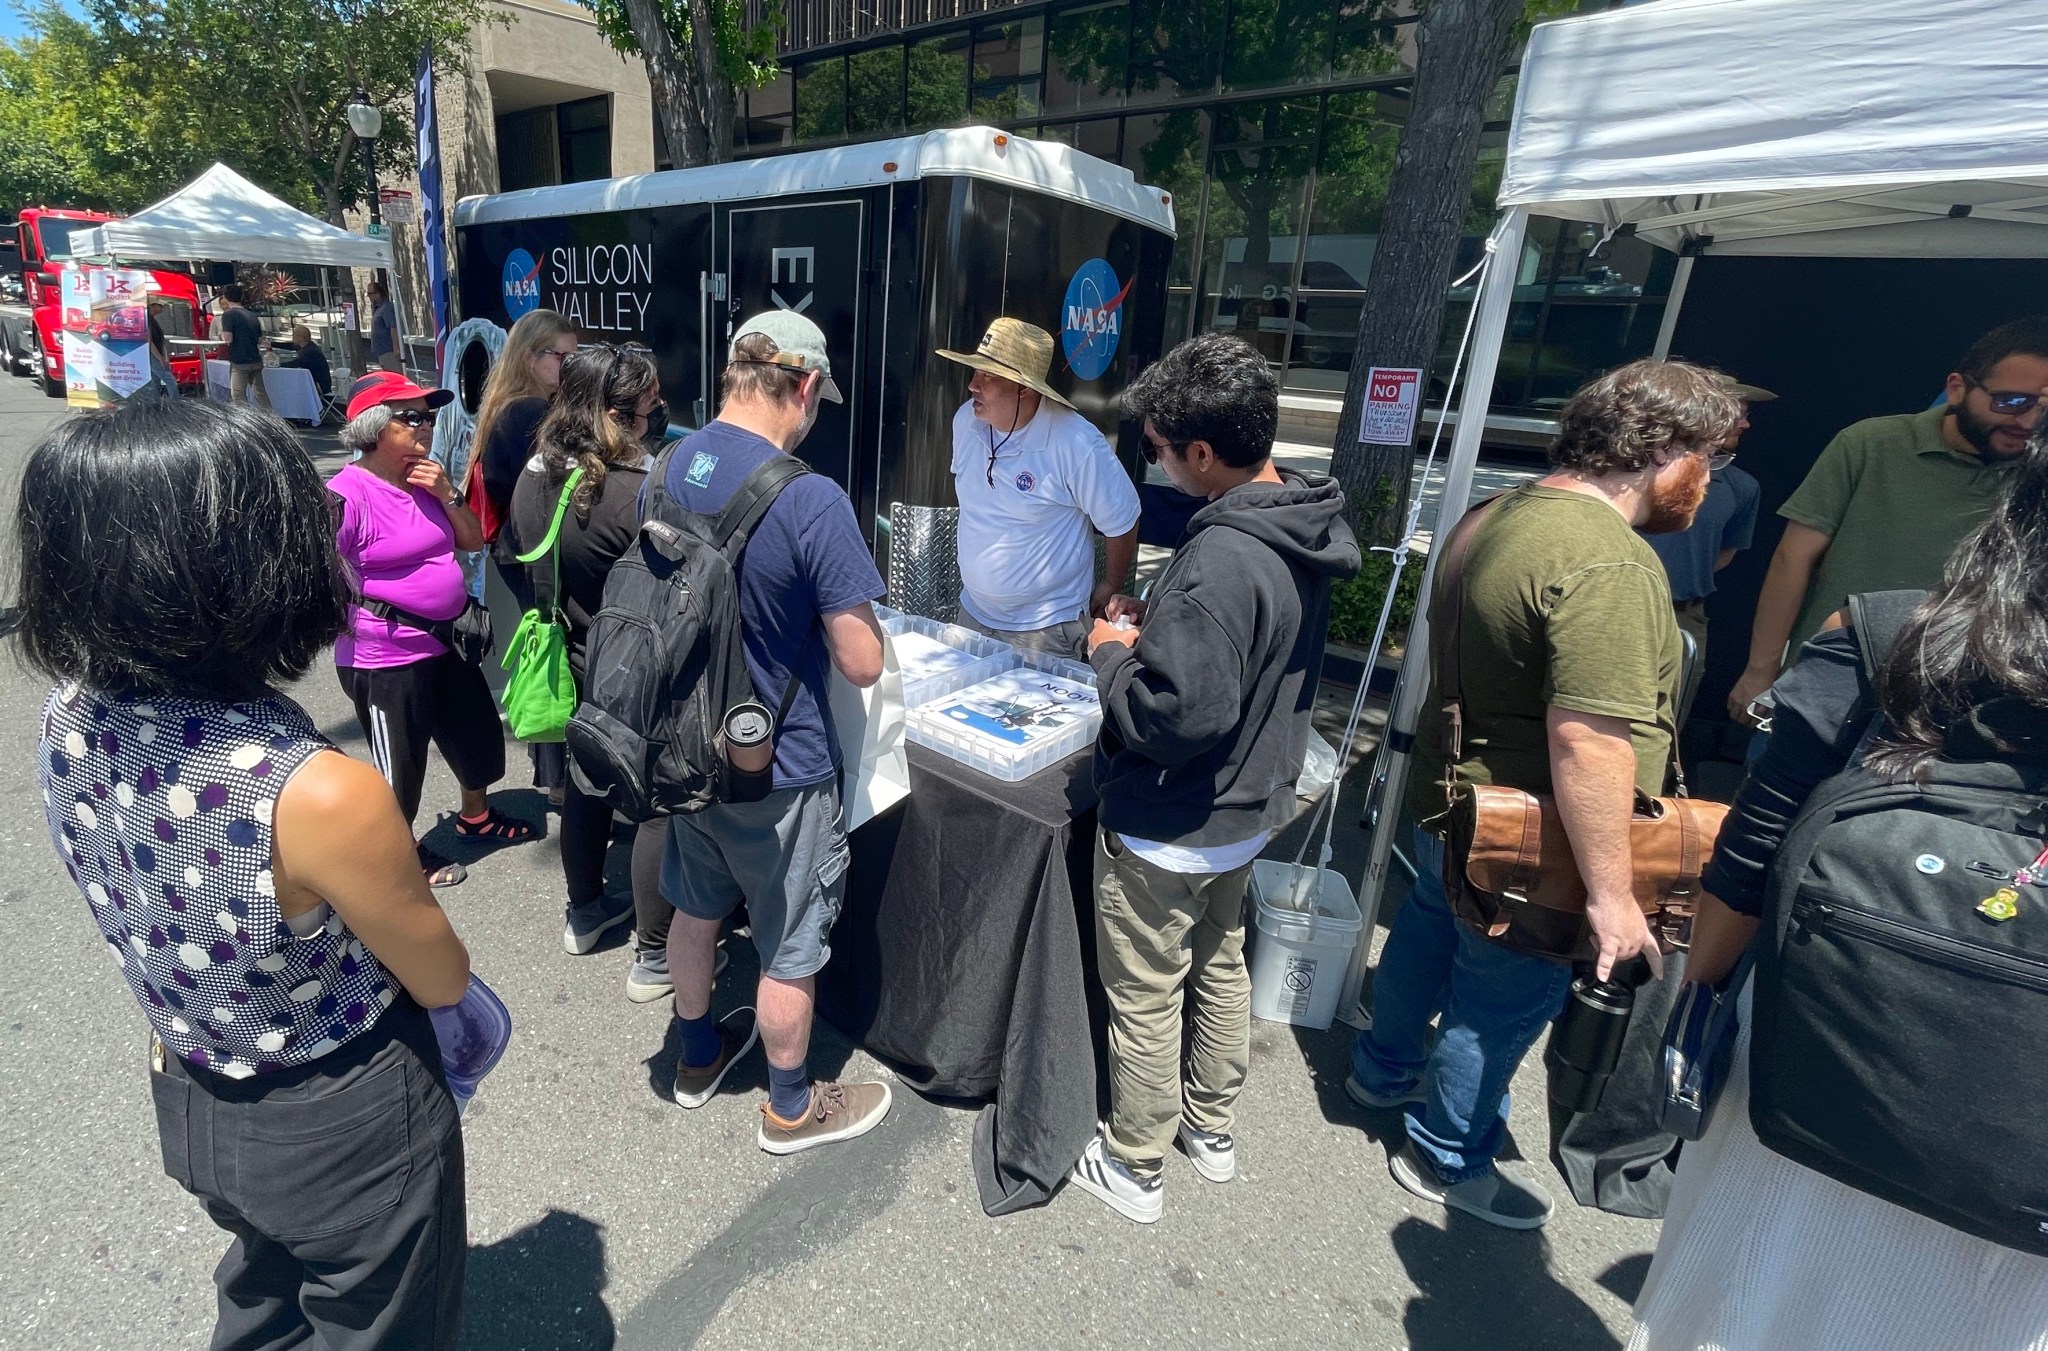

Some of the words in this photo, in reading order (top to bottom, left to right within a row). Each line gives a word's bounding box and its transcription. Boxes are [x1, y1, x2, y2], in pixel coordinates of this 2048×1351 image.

[369, 226, 378, 234] 24
[552, 243, 652, 286] SILICON
[505, 280, 539, 297] NASA
[552, 291, 652, 332] VALLEY
[1066, 305, 1118, 335] NASA
[109, 361, 136, 369] Building
[1373, 384, 1398, 398] NO
[1370, 402, 1410, 410] PARKING
[1040, 683, 1099, 703] MOON
